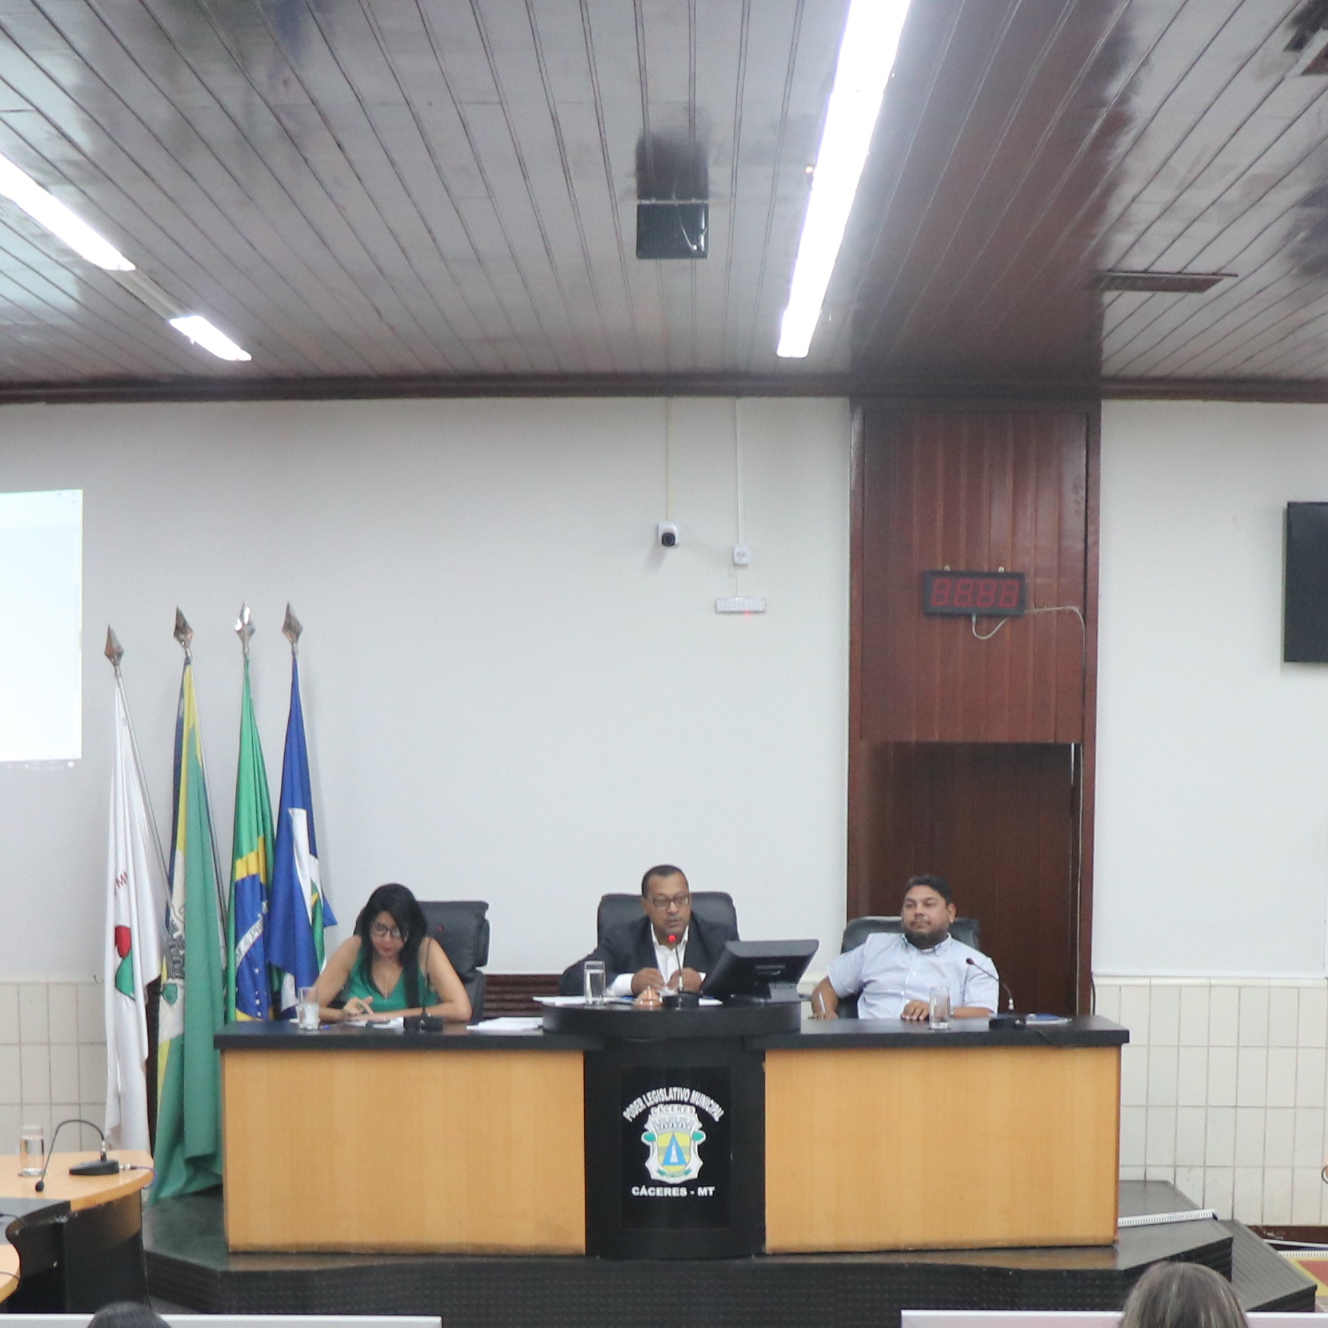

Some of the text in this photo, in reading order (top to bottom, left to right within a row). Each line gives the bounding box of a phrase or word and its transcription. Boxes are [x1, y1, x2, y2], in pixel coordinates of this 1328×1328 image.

[622, 1087, 725, 1122] PODER LEGISLATIVO MUNICIPAL
[631, 1184, 687, 1197] CÁCERES
[697, 1186, 715, 1197] MT
